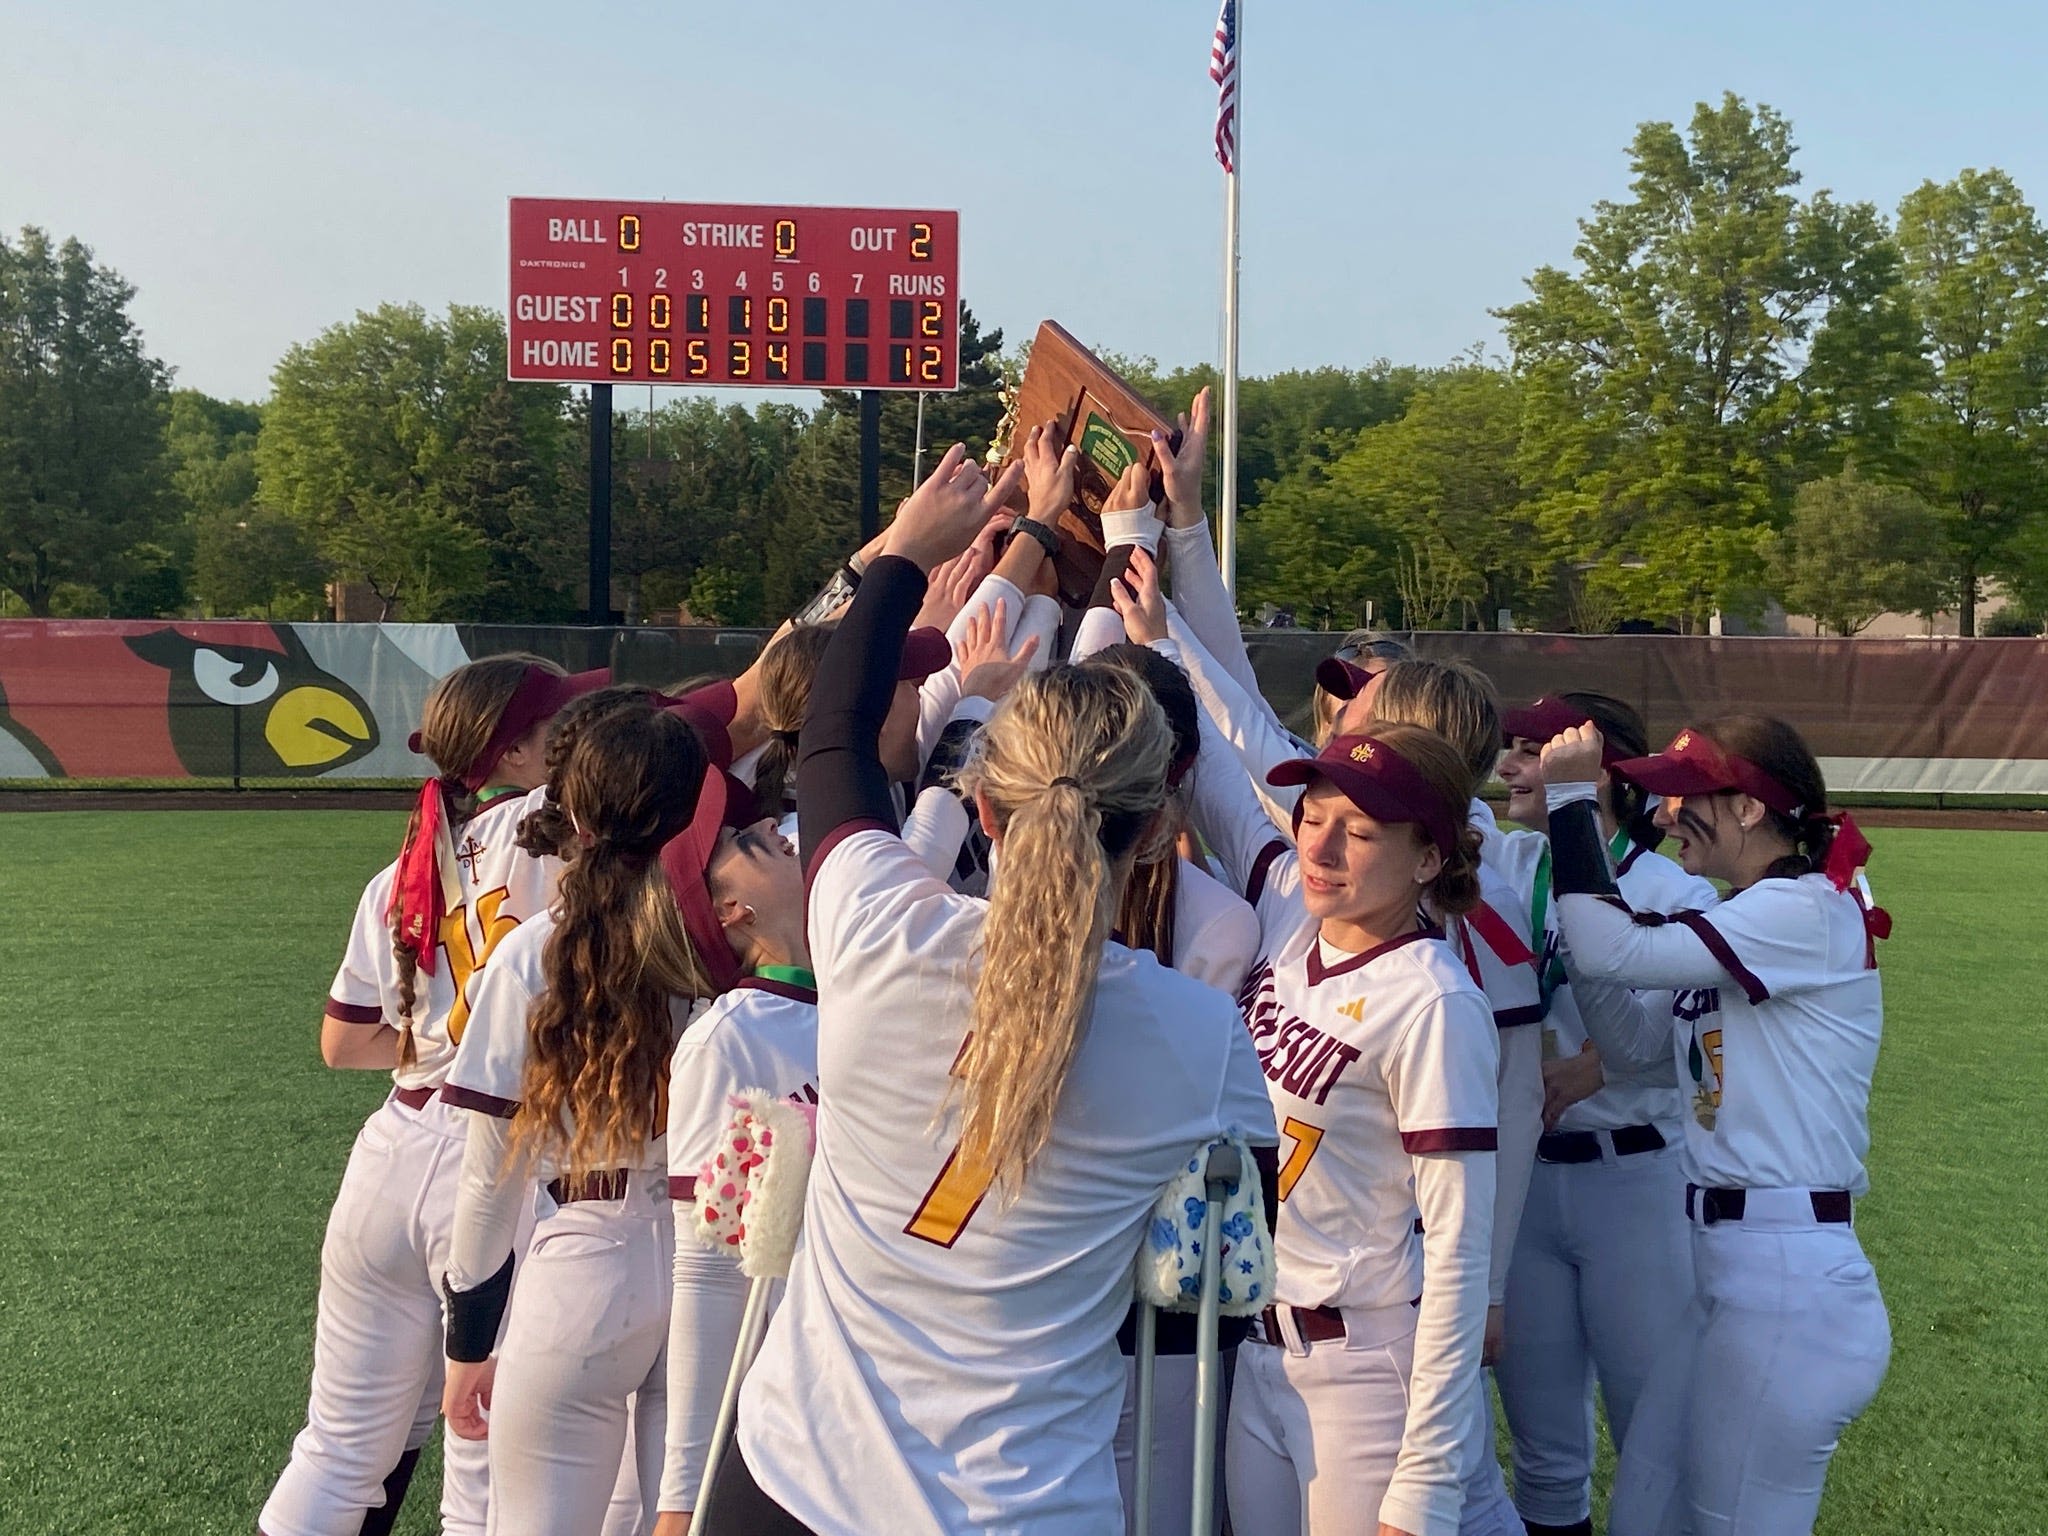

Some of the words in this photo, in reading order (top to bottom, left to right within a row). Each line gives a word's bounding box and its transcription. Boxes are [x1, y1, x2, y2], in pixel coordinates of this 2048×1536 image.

[549, 218, 607, 243] BALL
[619, 215, 640, 250] 0
[682, 222, 764, 249] STRIKE
[775, 220, 796, 255] 0
[850, 226, 897, 252] OUT
[911, 223, 931, 258] 2
[519, 259, 586, 270] DAKTRONICS
[617, 266, 629, 288] 1
[654, 268, 668, 289] 2
[691, 269, 704, 290] 3
[735, 270, 748, 291] 4
[772, 272, 784, 292] 5
[808, 272, 821, 293] 6
[851, 273, 864, 294] 7
[889, 274, 946, 297] RUNS
[515, 294, 602, 323] GUEST
[612, 293, 632, 328] 0
[650, 294, 671, 329] 0
[701, 297, 709, 328] 1
[744, 299, 751, 329] 1
[767, 298, 788, 333] 0
[921, 301, 942, 336] 2
[522, 339, 599, 368] HOME
[611, 338, 632, 373] 0
[650, 339, 670, 374] 0
[687, 340, 708, 375] 5
[732, 341, 750, 376] 3
[767, 344, 788, 375] 4
[905, 345, 942, 381] 12
[1277, 1116, 1325, 1203] 7
